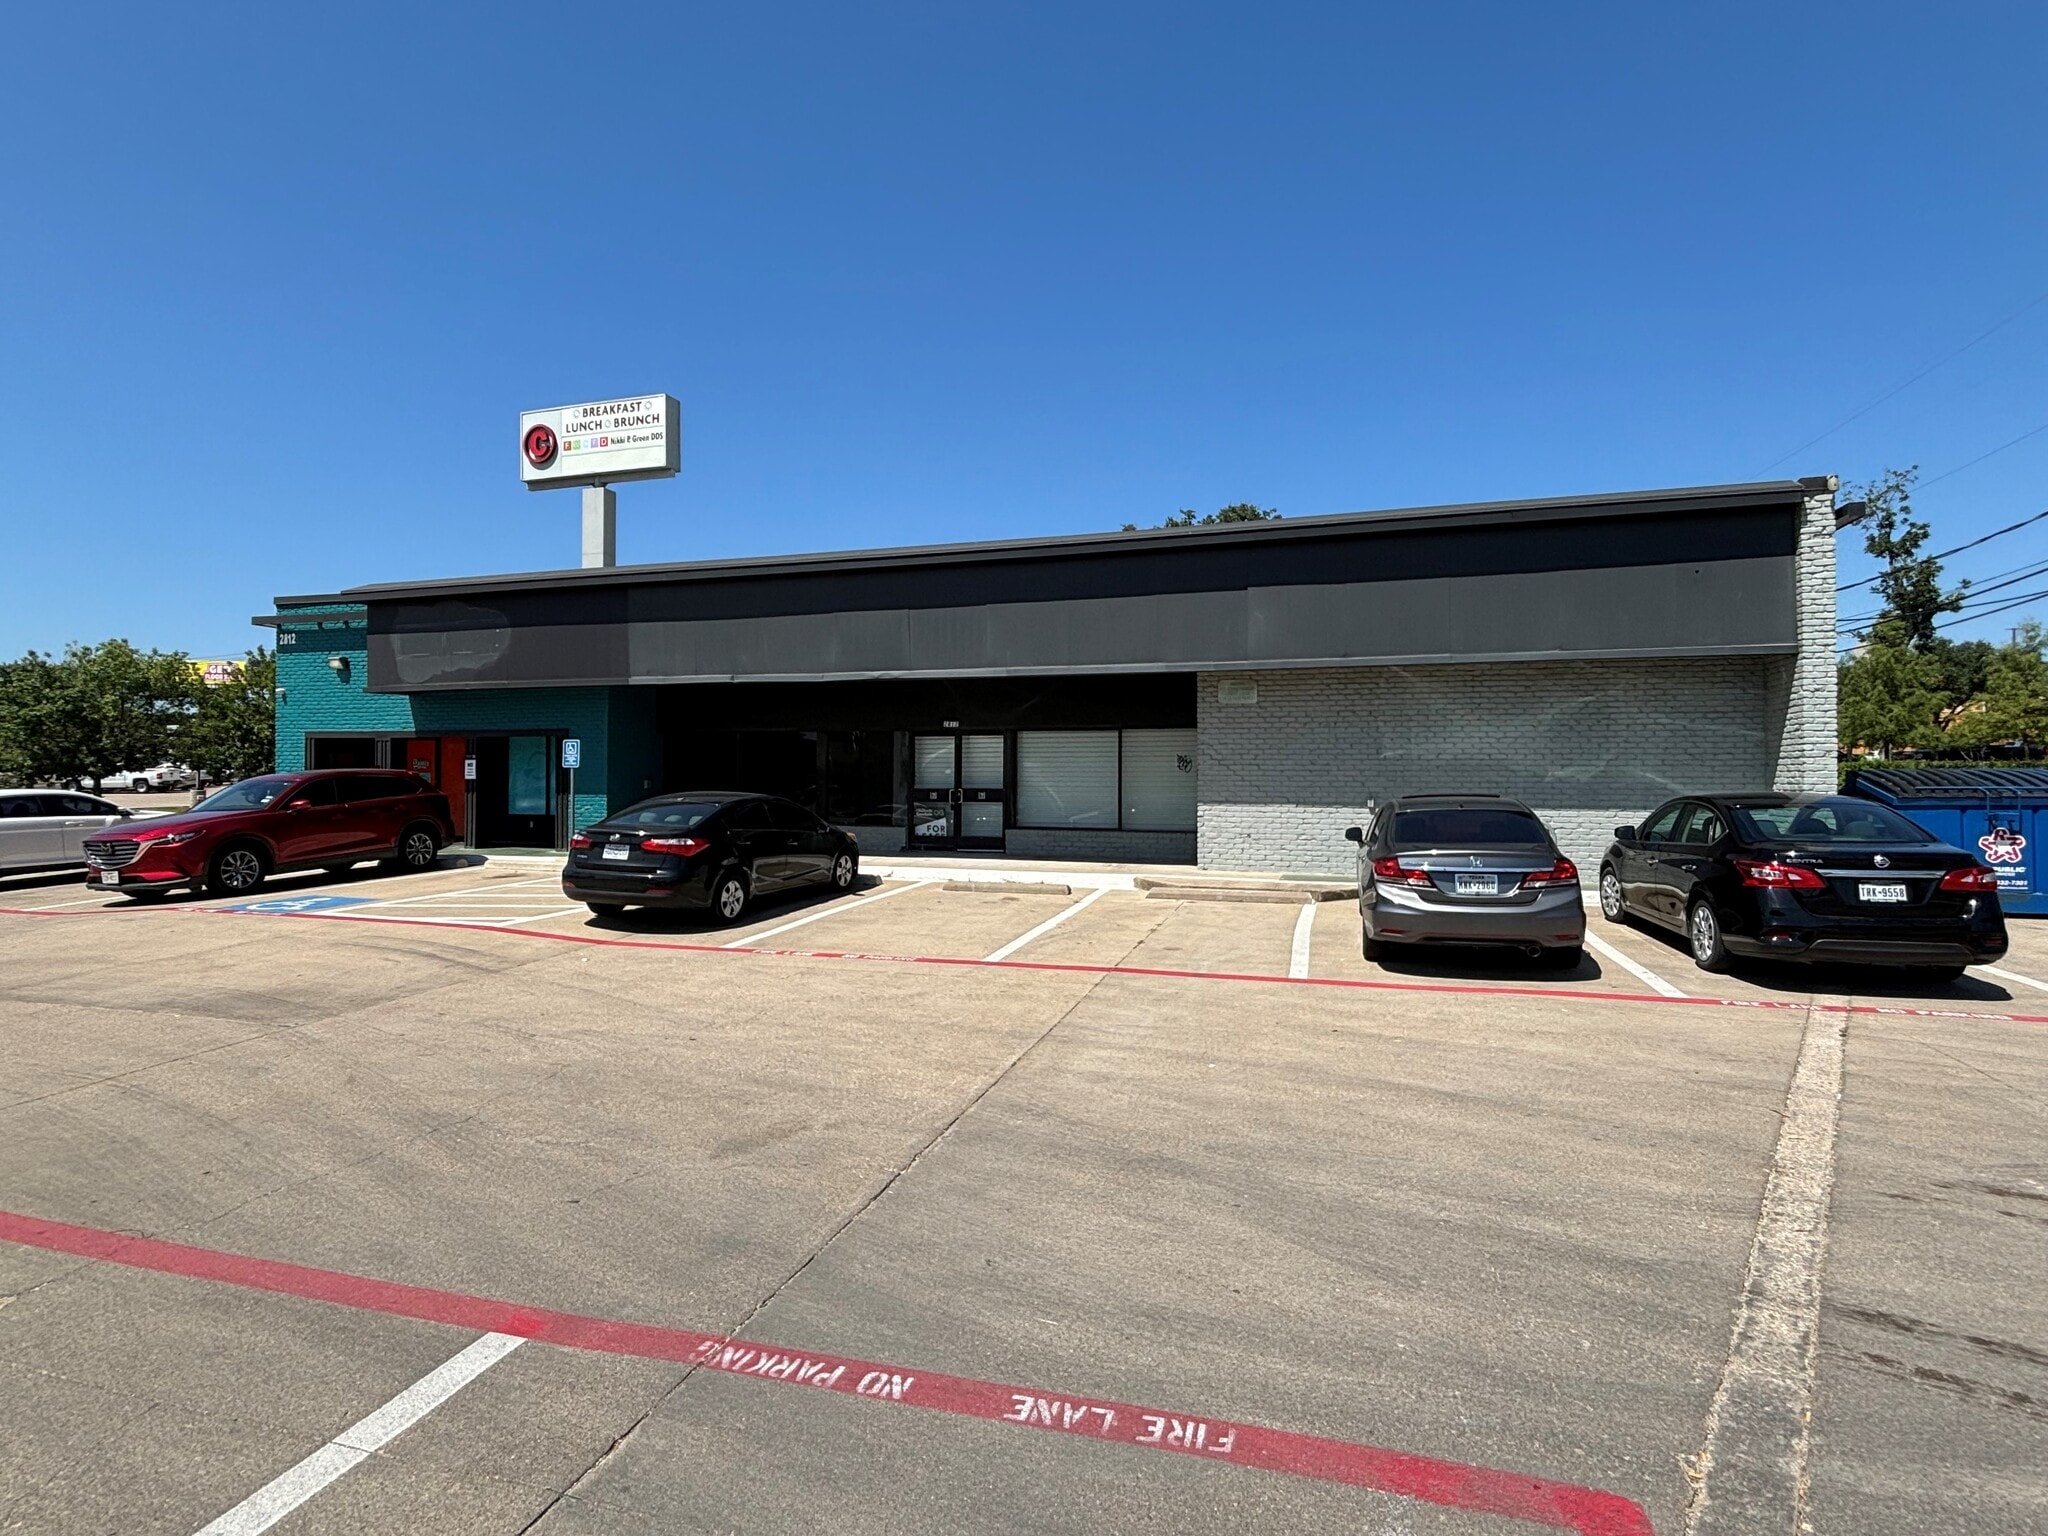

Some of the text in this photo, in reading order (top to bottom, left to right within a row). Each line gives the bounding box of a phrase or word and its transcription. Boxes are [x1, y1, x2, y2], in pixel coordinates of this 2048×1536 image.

[582, 401, 642, 418] BREAKFAST
[566, 413, 660, 433] LUNCH BRUNCH
[610, 435, 626, 445] Nikki
[632, 433, 650, 443] Green
[650, 431, 664, 441] DDS
[279, 633, 296, 645] 2812
[926, 824, 946, 833] FOR
[689, 1339, 1236, 1454] FIRE LANE NO PARKING
